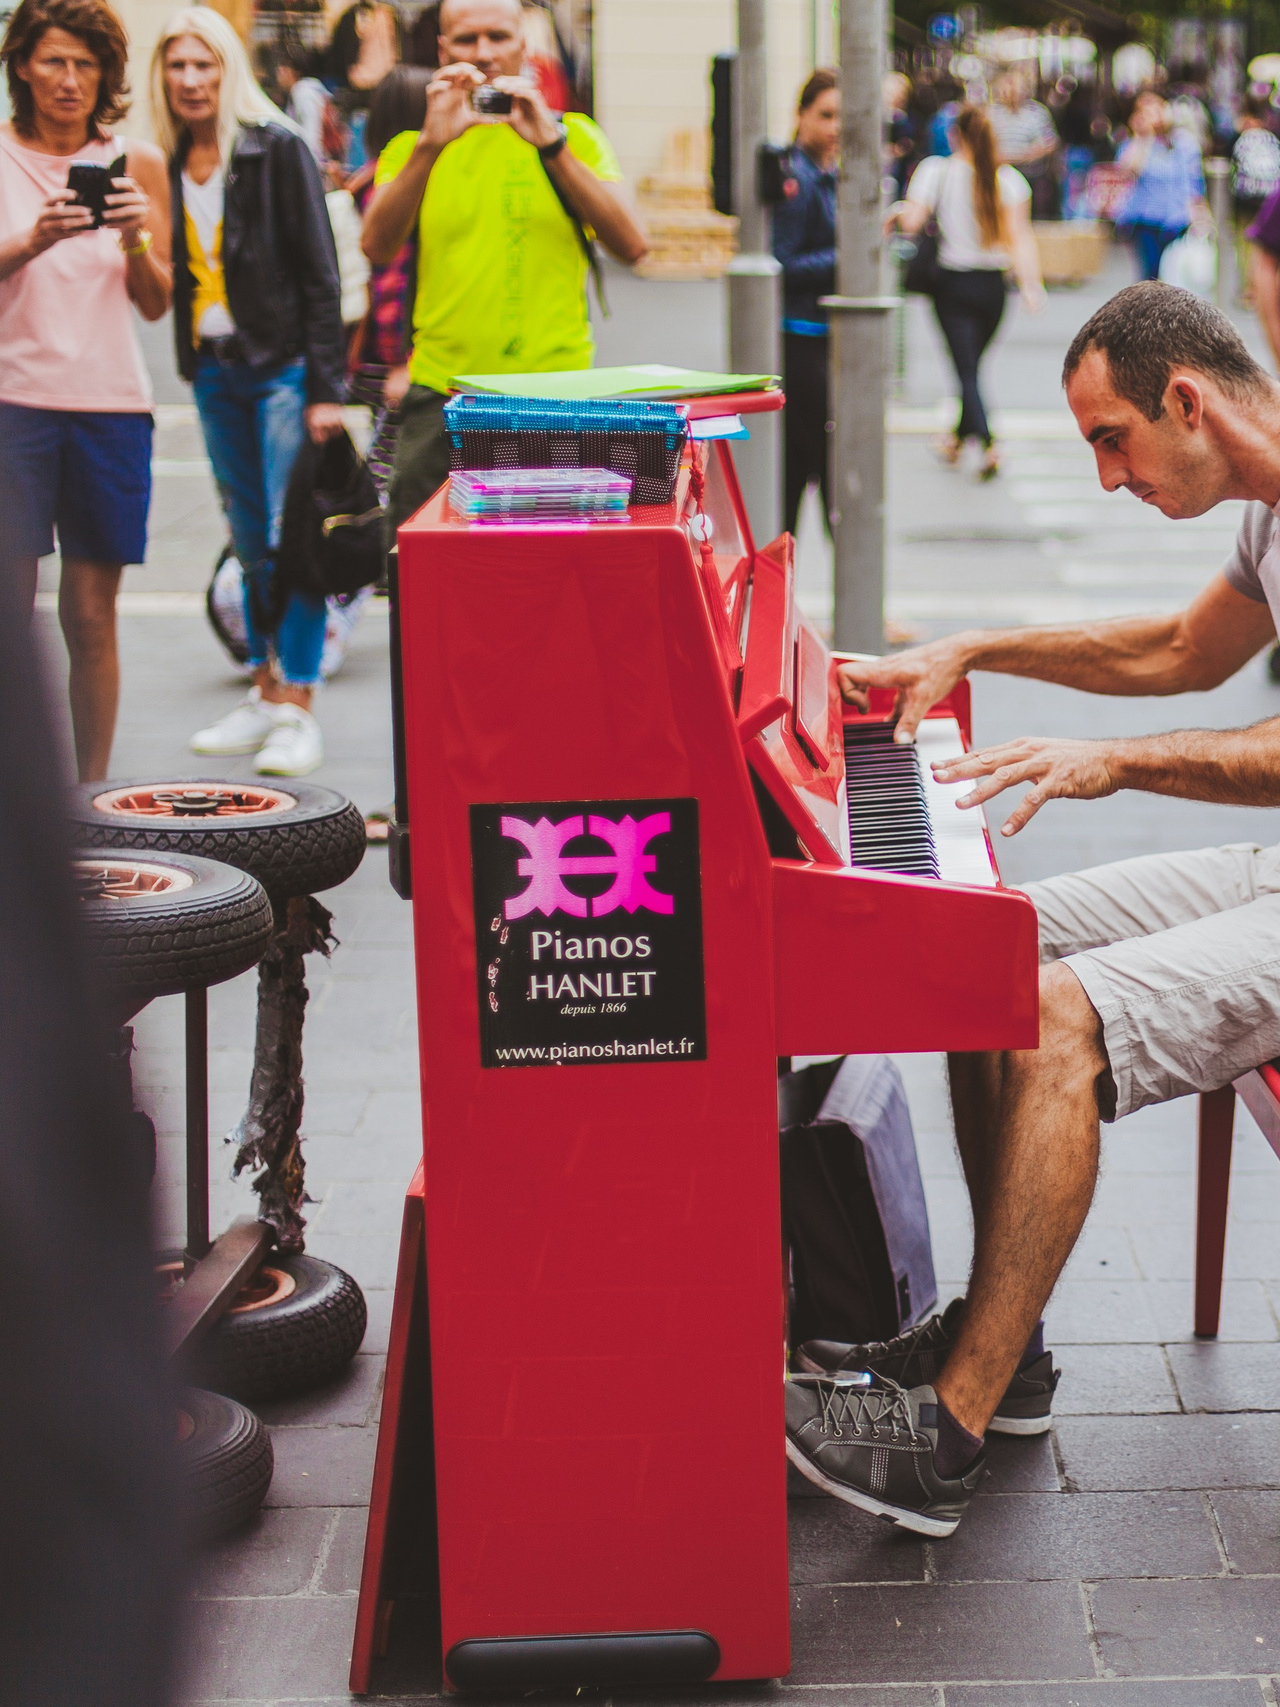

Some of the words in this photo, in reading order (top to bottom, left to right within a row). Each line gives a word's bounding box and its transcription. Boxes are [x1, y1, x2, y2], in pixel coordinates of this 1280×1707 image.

[532, 931, 652, 960] Pianos
[532, 971, 656, 999] HANLET
[560, 1004, 596, 1017] depuis
[600, 1002, 627, 1014] 1866
[497, 1038, 695, 1059] www.pianoshanlet.fr
